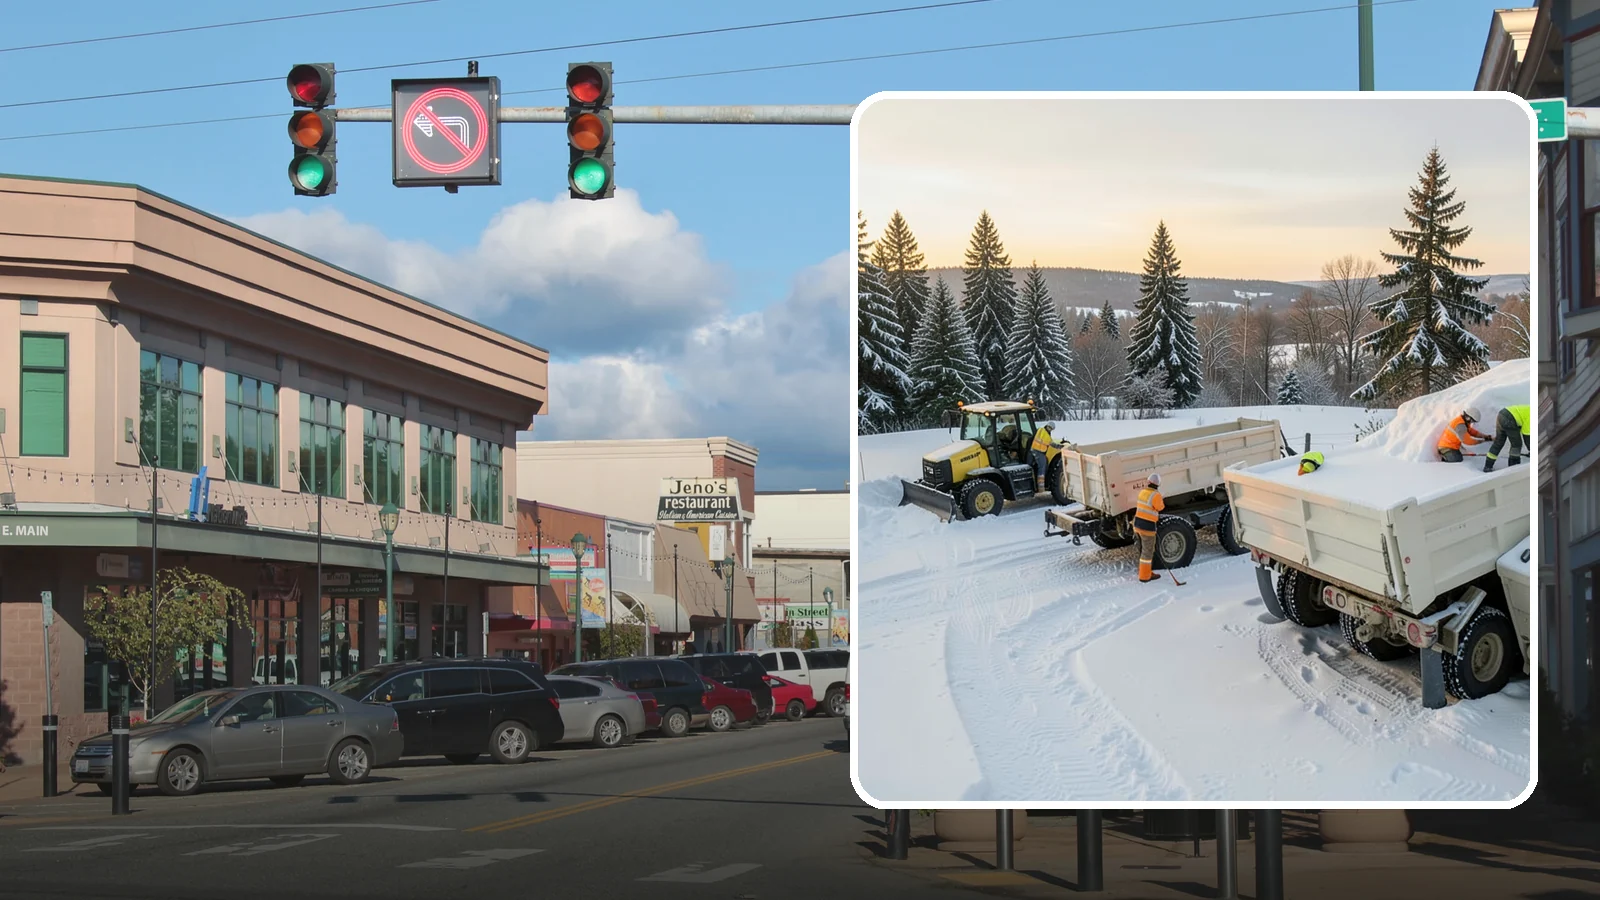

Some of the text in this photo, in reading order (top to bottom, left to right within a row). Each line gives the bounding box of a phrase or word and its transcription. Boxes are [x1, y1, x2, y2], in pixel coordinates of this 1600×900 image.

[670, 480, 728, 495] Jeno's
[665, 496, 731, 509] restaurant
[658, 510, 681, 519] Italian
[686, 509, 714, 519] American
[715, 509, 737, 519] Cuisine
[2, 525, 49, 536] E. MAIN
[786, 607, 795, 617] in
[797, 607, 829, 617] Street
